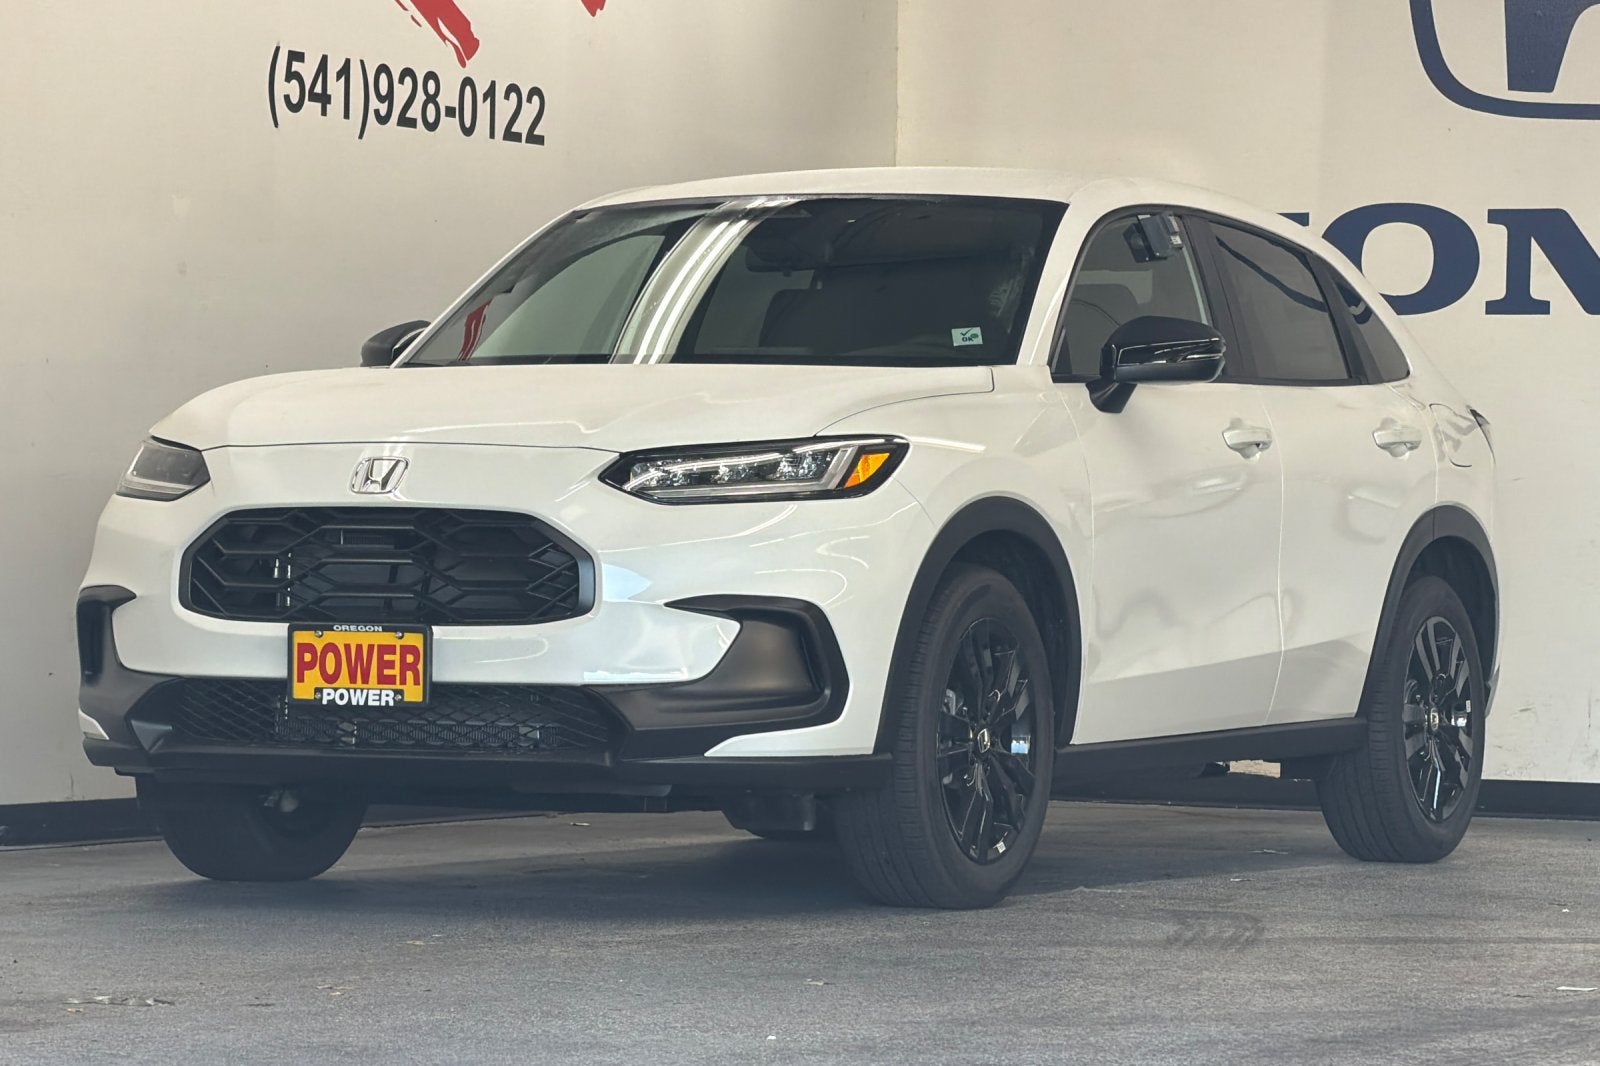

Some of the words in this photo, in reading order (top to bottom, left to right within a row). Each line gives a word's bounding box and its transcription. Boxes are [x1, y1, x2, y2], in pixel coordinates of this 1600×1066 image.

[268, 44, 546, 146] (541)928-0122
[333, 624, 383, 632] OREGON
[296, 642, 421, 686] POWER
[321, 688, 394, 706] POWER
